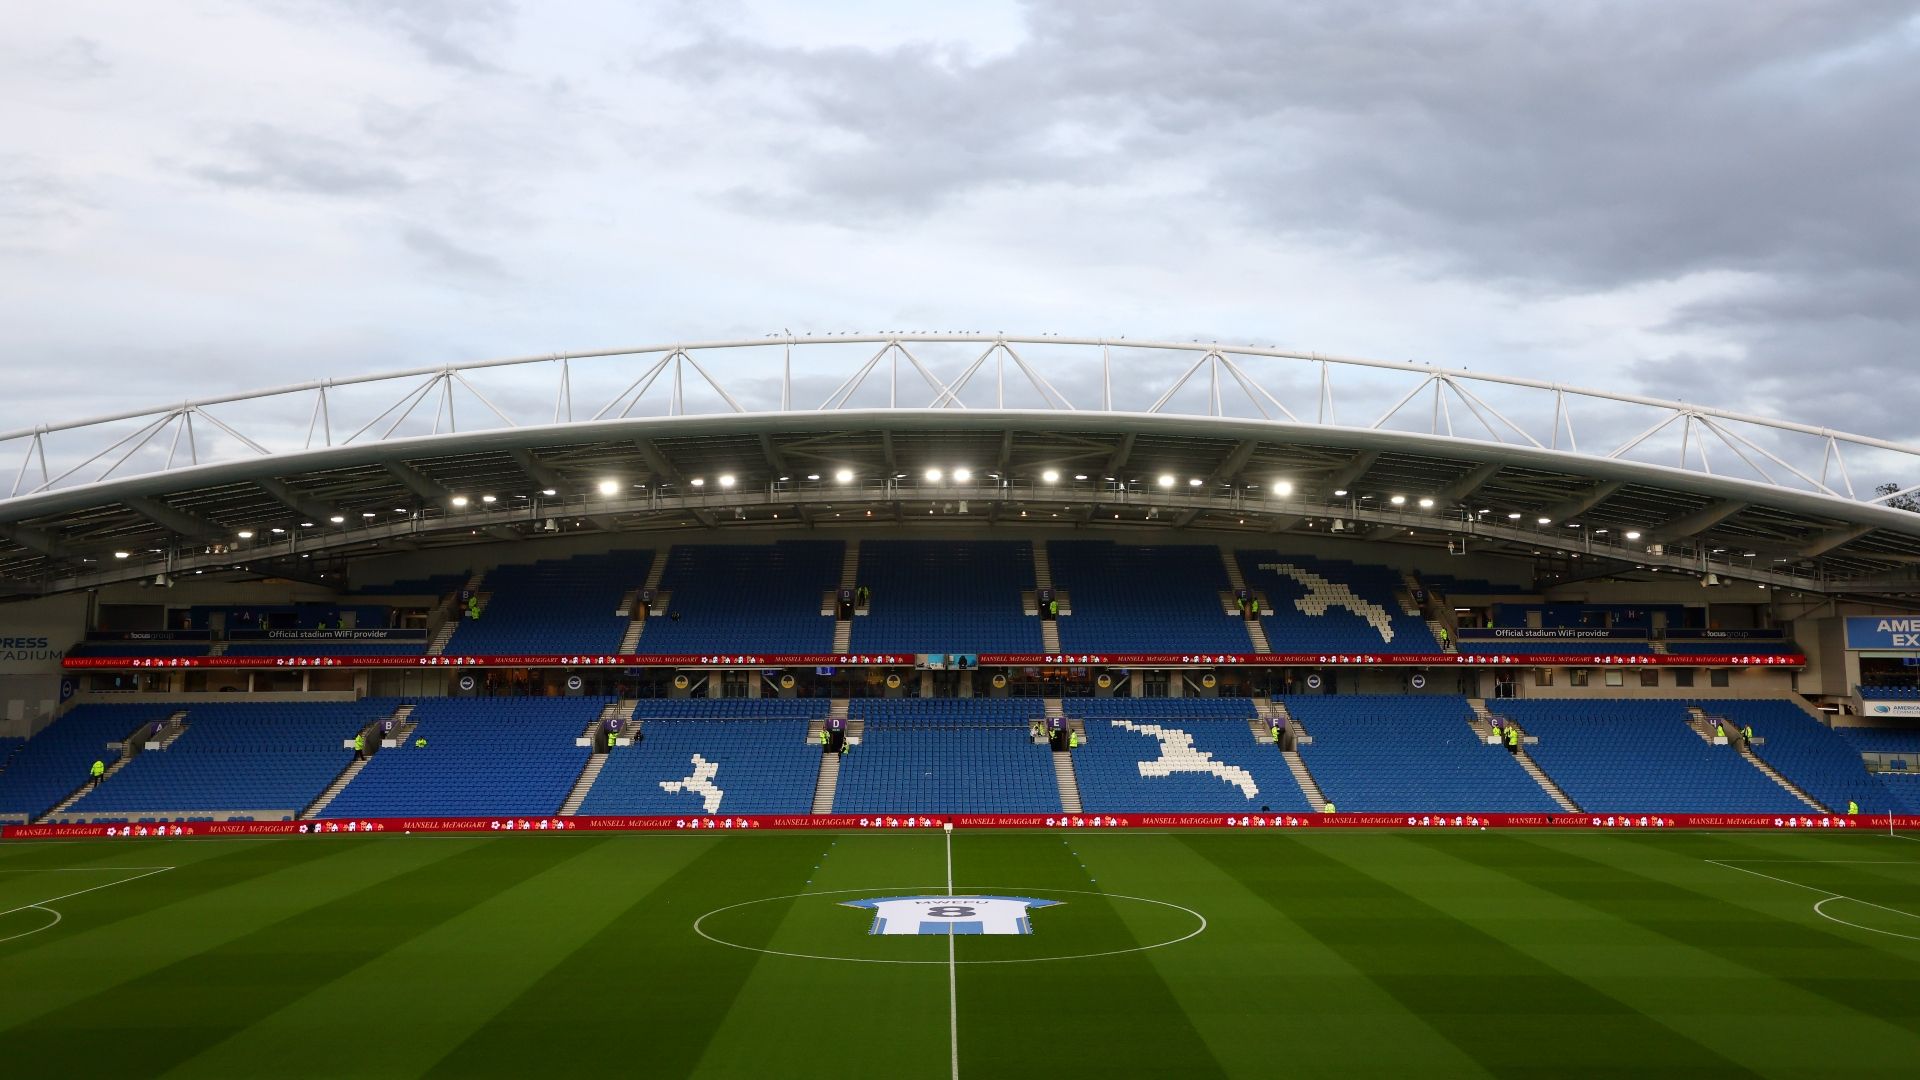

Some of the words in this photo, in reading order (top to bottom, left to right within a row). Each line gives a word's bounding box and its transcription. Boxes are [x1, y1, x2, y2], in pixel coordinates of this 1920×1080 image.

[463, 591, 469, 599] B
[1877, 619, 1920, 632] AME
[354, 631, 387, 640] provider
[1577, 630, 1609, 638] provider
[0, 638, 48, 649] RESS
[1892, 634, 1920, 647] EX
[610, 720, 617, 728] C
[833, 720, 839, 728] D
[1053, 719, 1060, 727] E
[403, 821, 440, 829] MANSELL
[16, 828, 52, 837] MANSELL
[56, 827, 103, 836] McTAGGART
[927, 906, 976, 917] 8
